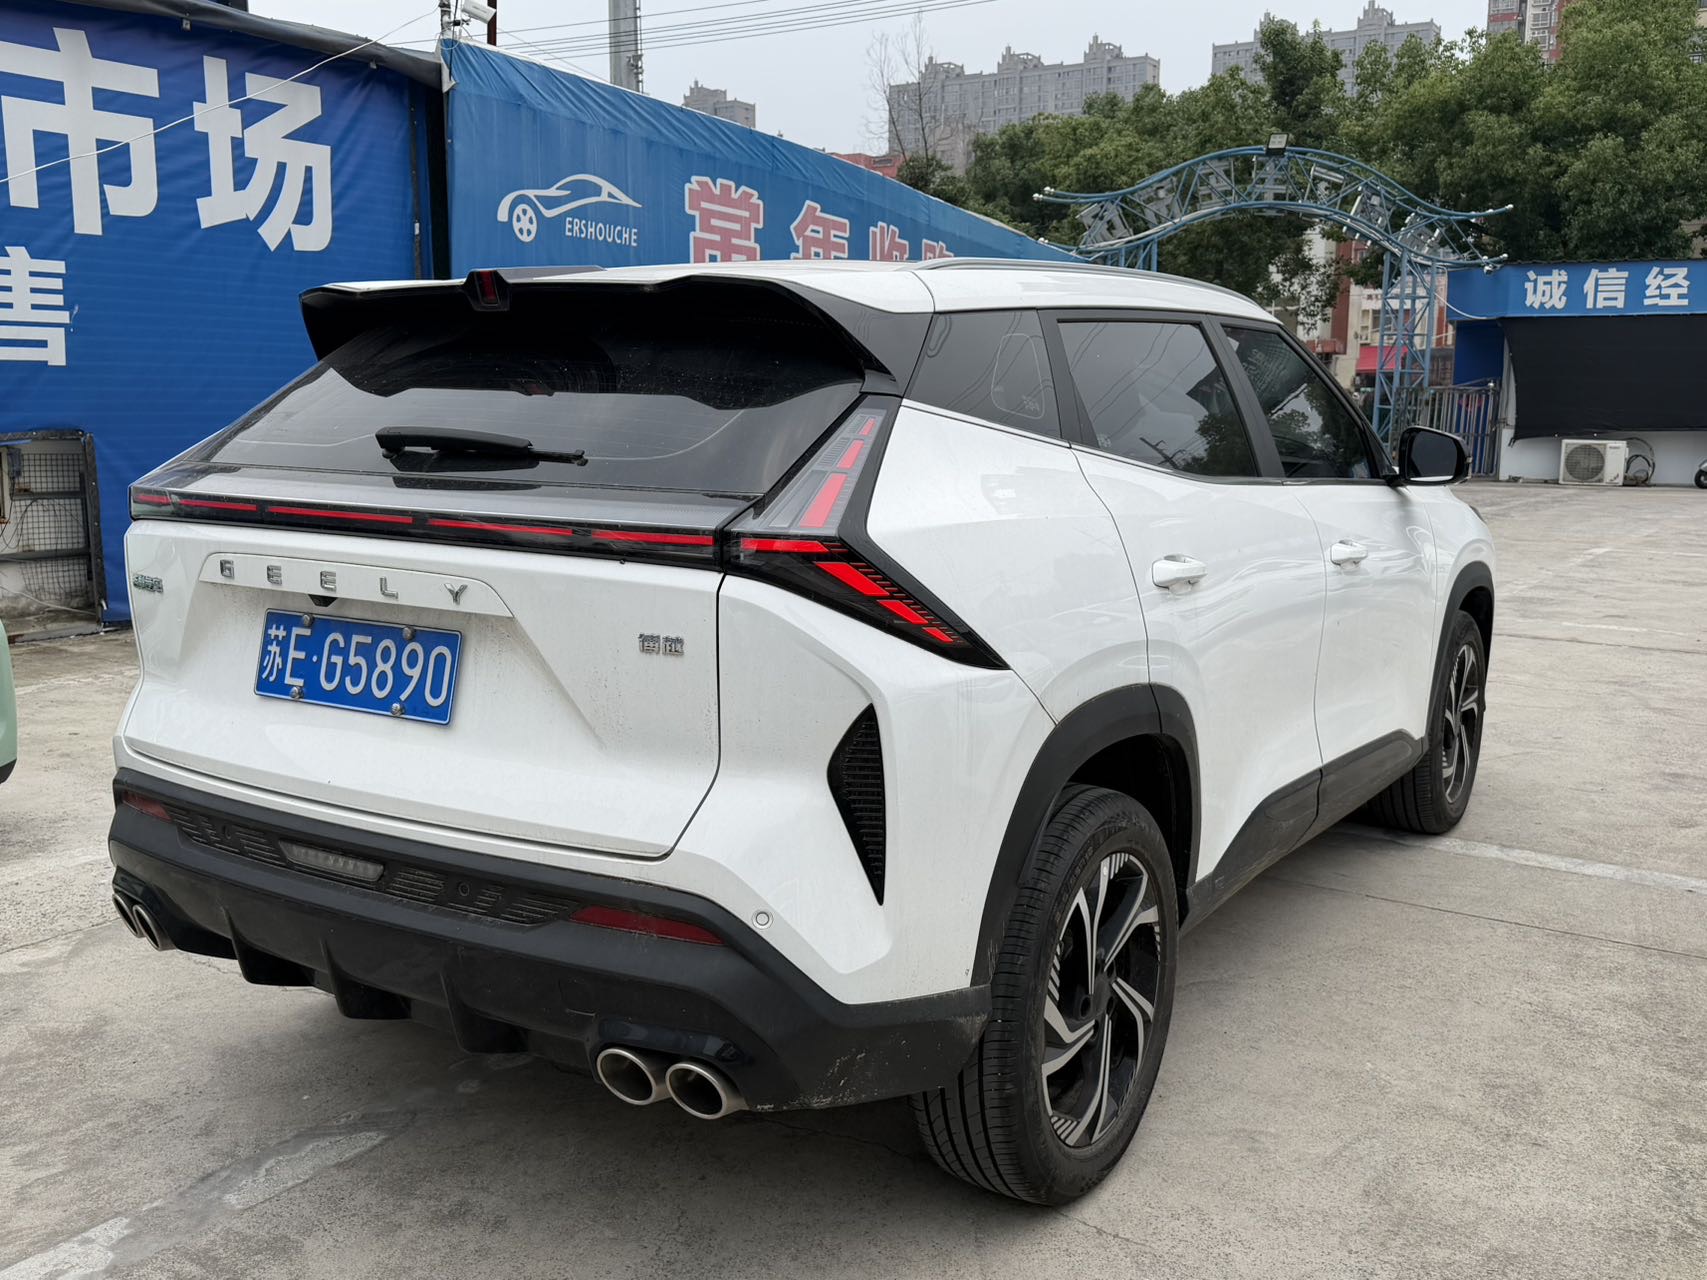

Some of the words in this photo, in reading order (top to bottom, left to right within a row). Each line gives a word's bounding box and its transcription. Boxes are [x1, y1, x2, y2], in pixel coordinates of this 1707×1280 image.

[0, 27, 333, 252] 市场
[565, 217, 638, 247] ERSHOUCHE
[1523, 266, 1691, 310] 诚信经
[219, 559, 468, 605] GEELY
